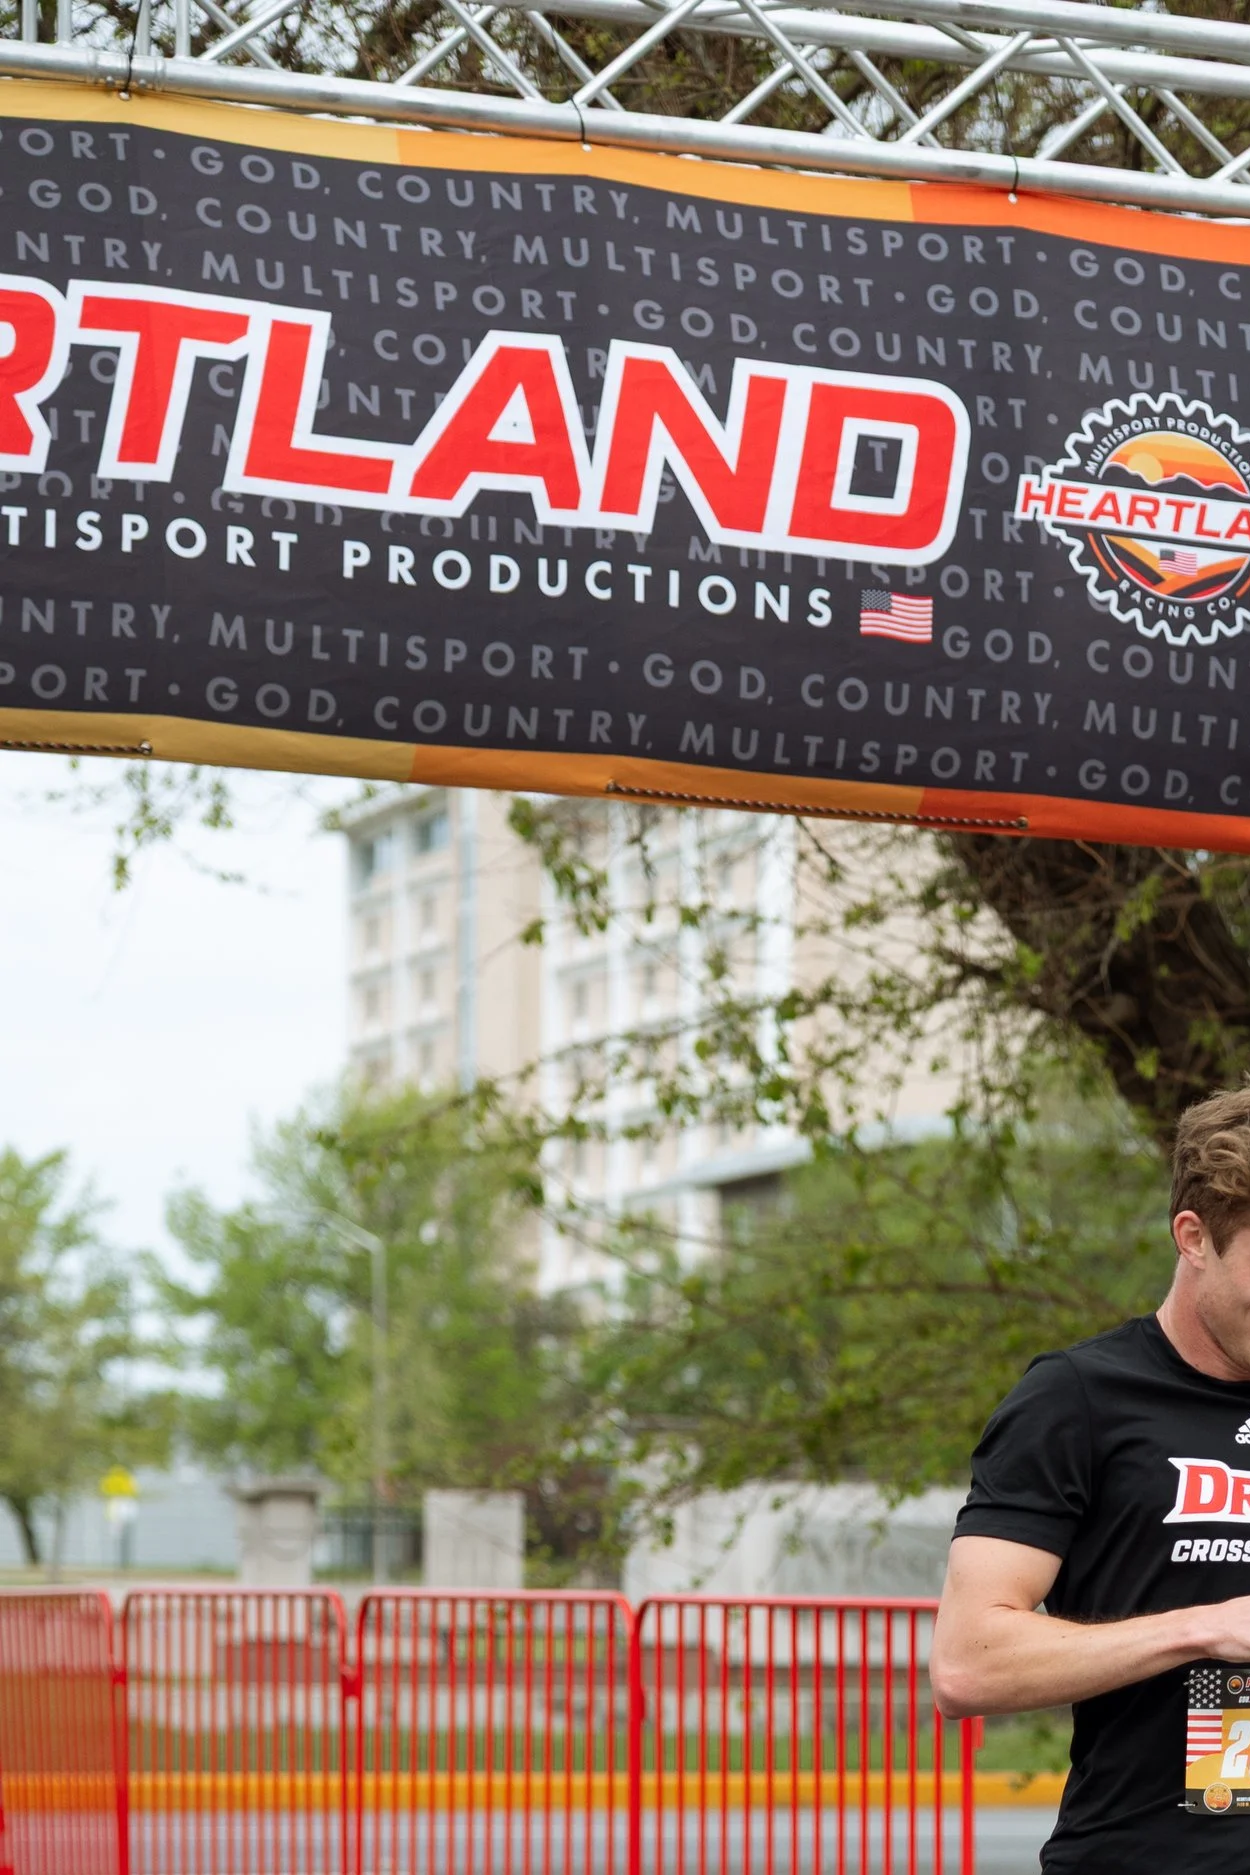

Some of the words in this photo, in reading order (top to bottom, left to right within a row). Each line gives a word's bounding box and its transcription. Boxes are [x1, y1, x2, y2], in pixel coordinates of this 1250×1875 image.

[0, 128, 130, 160] ORT
[191, 146, 330, 194] GOD,
[358, 171, 639, 224] COUNTRY,
[667, 202, 1015, 264] MULTISPORT
[1070, 249, 1194, 297] GOD,
[29, 179, 167, 220] GOD,
[196, 198, 486, 263] COUNTRY,
[513, 235, 873, 307] MULTISPORT
[927, 284, 1048, 324] GOD,
[202, 251, 576, 321] MULTISPORT
[633, 300, 766, 349] GOD,
[793, 323, 1052, 379] COUNTRY,
[1085, 417, 1160, 475] MULTISPORT
[1, 505, 298, 572] TISPORT
[343, 539, 832, 628] PRODUCTIONS
[1119, 580, 1195, 618] RACING
[1207, 598, 1235, 616] CO.
[0, 596, 179, 643] NTRY,
[209, 612, 588, 680] MULTISPORT
[643, 653, 773, 704] GOD,
[801, 674, 1058, 729] COUNTRY,
[943, 626, 1059, 668] GOD,
[206, 677, 343, 726] GOD,
[374, 696, 652, 749] COUNTRY,
[680, 721, 1029, 782] MULTISPORT
[1079, 759, 1193, 803] GOD,
